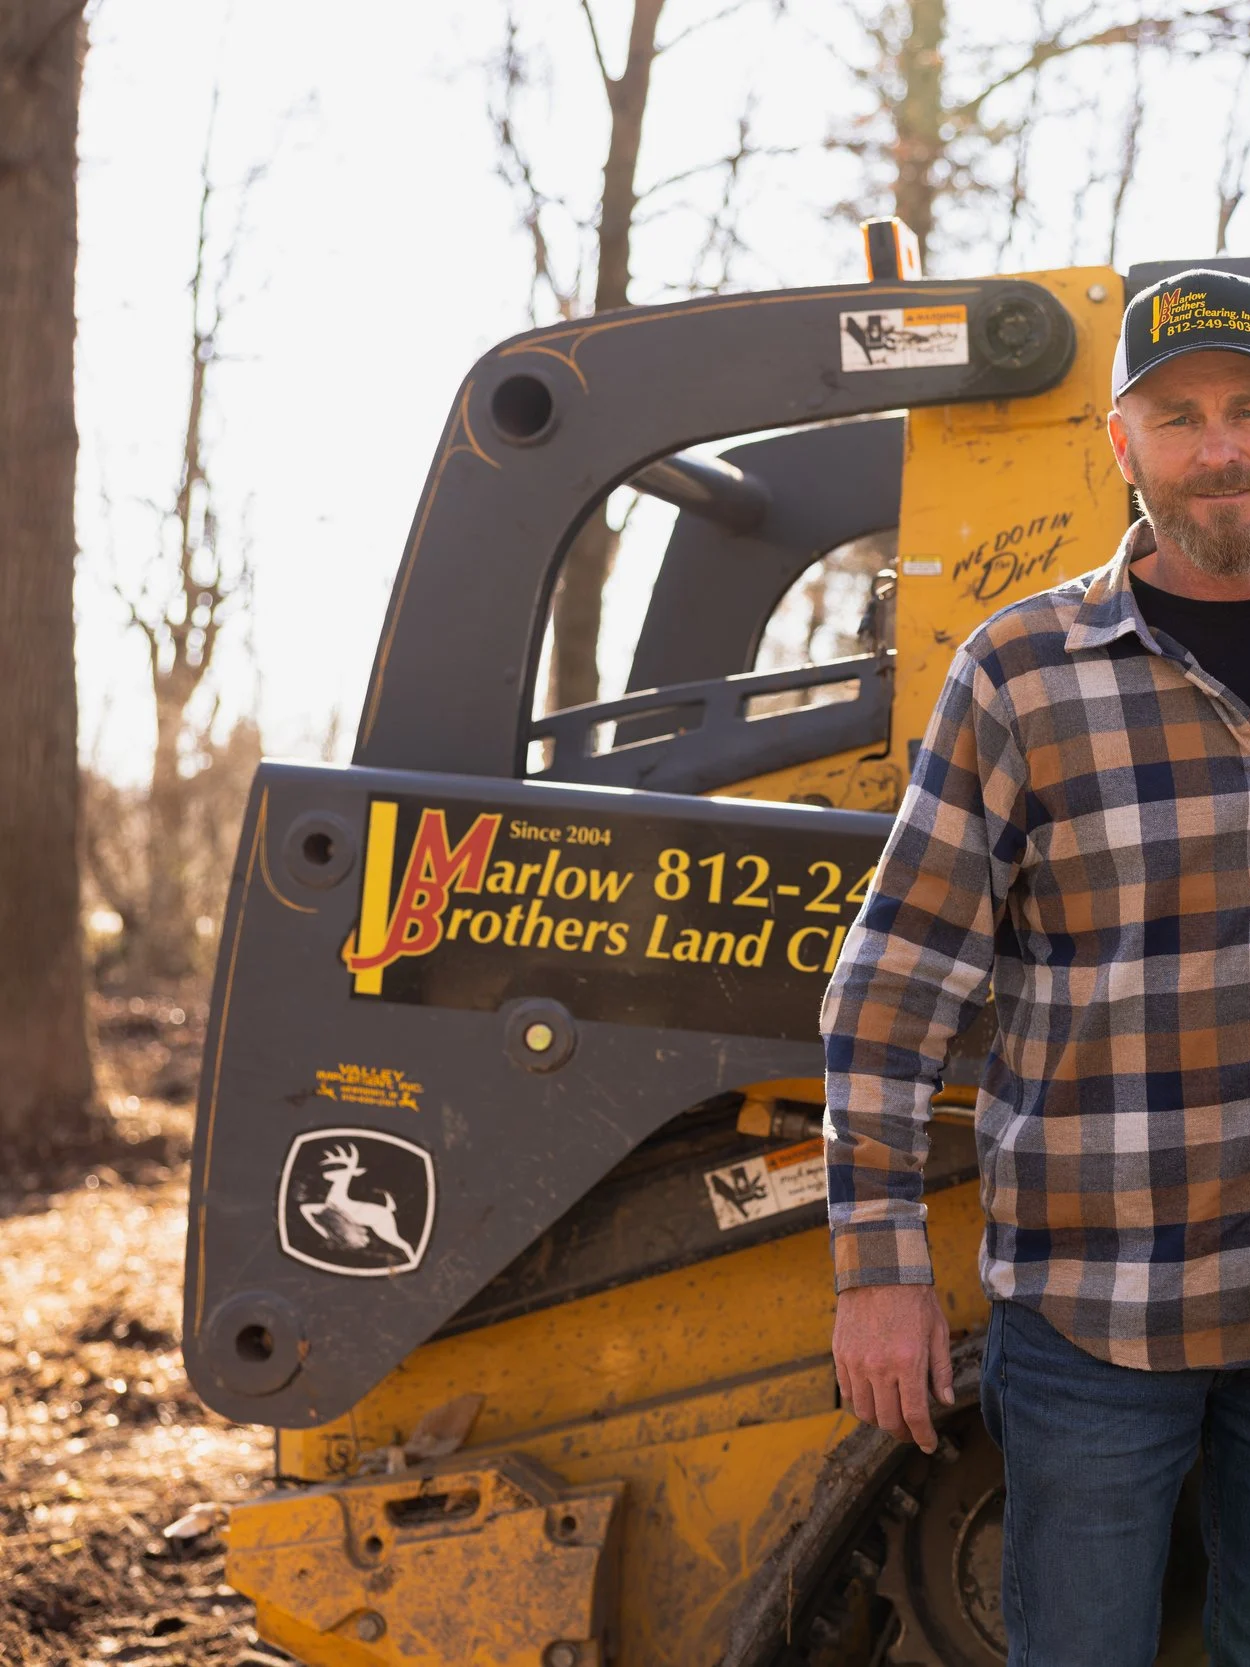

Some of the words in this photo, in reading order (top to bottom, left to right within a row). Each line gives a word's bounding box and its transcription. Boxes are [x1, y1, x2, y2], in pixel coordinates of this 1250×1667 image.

[1161, 300, 1205, 323] Brothers
[1162, 288, 1207, 306] Marlow
[1169, 310, 1192, 324] Land
[1194, 308, 1239, 319] Clearing,
[952, 541, 989, 581] WE
[994, 524, 1024, 552] DO
[1028, 515, 1048, 537] IT
[1050, 511, 1073, 530] IN
[974, 535, 1079, 600] Dirt
[412, 808, 634, 904] Marlow
[509, 820, 562, 842] Since
[566, 824, 612, 847] 2004
[390, 887, 630, 957] Brothers
[645, 914, 774, 968] Land
